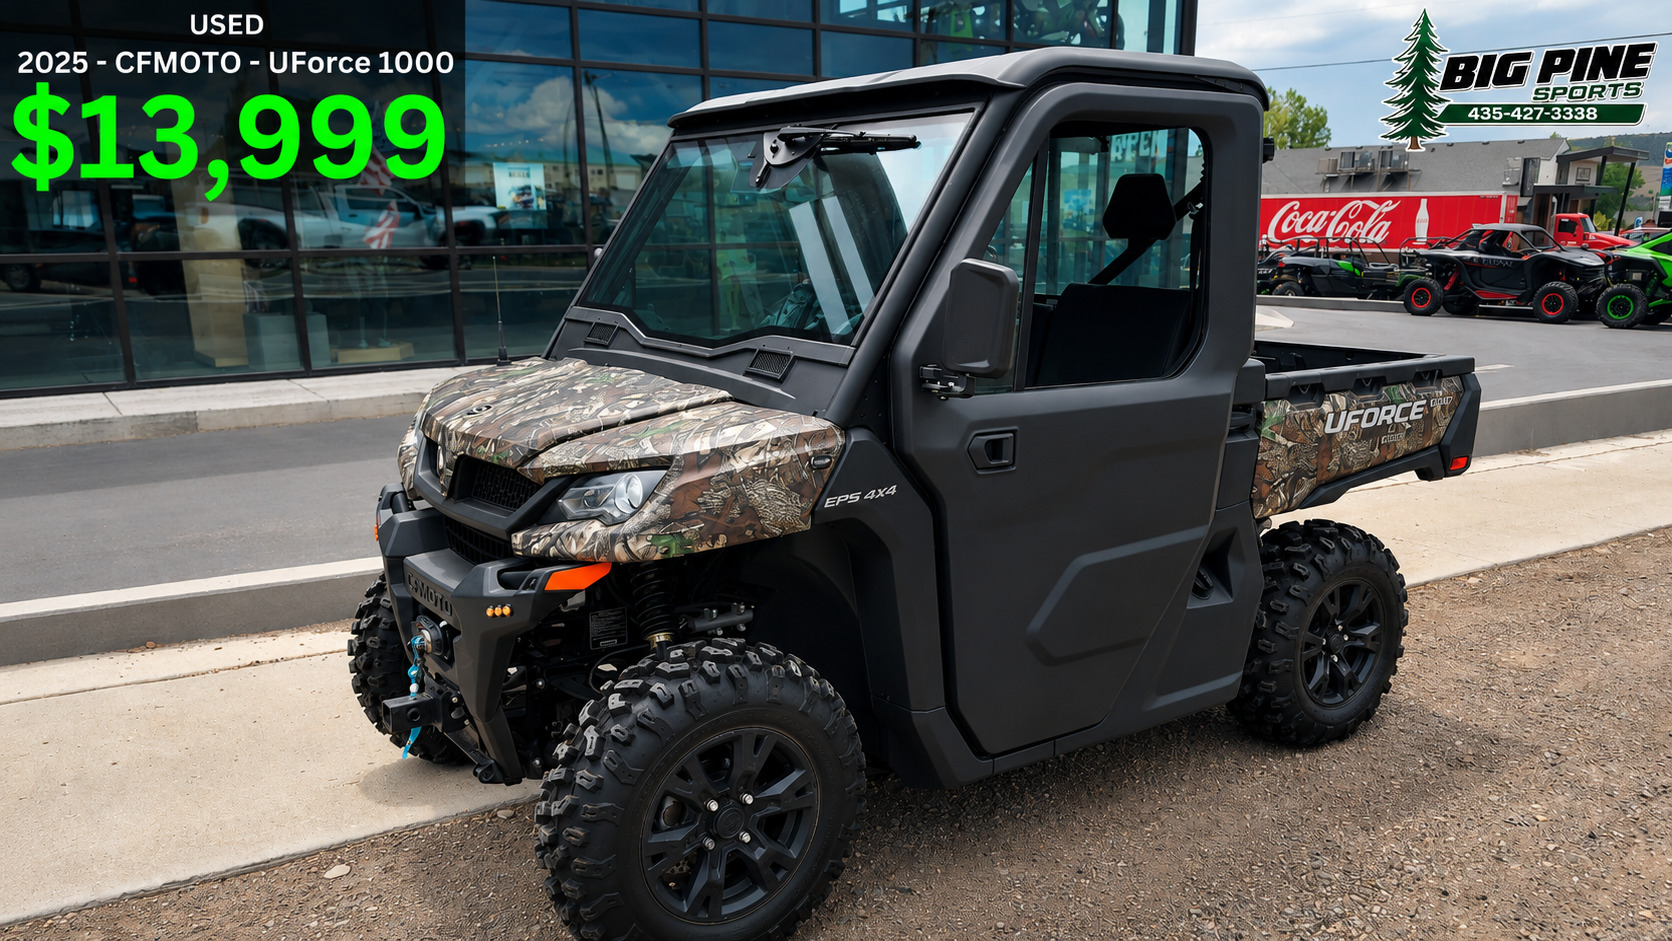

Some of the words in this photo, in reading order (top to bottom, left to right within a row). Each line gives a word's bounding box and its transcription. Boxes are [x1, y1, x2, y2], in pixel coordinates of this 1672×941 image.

[1267, 200, 1401, 244] Coca-Cola
[1324, 399, 1427, 434] UFORCE
[824, 492, 862, 508] EPS
